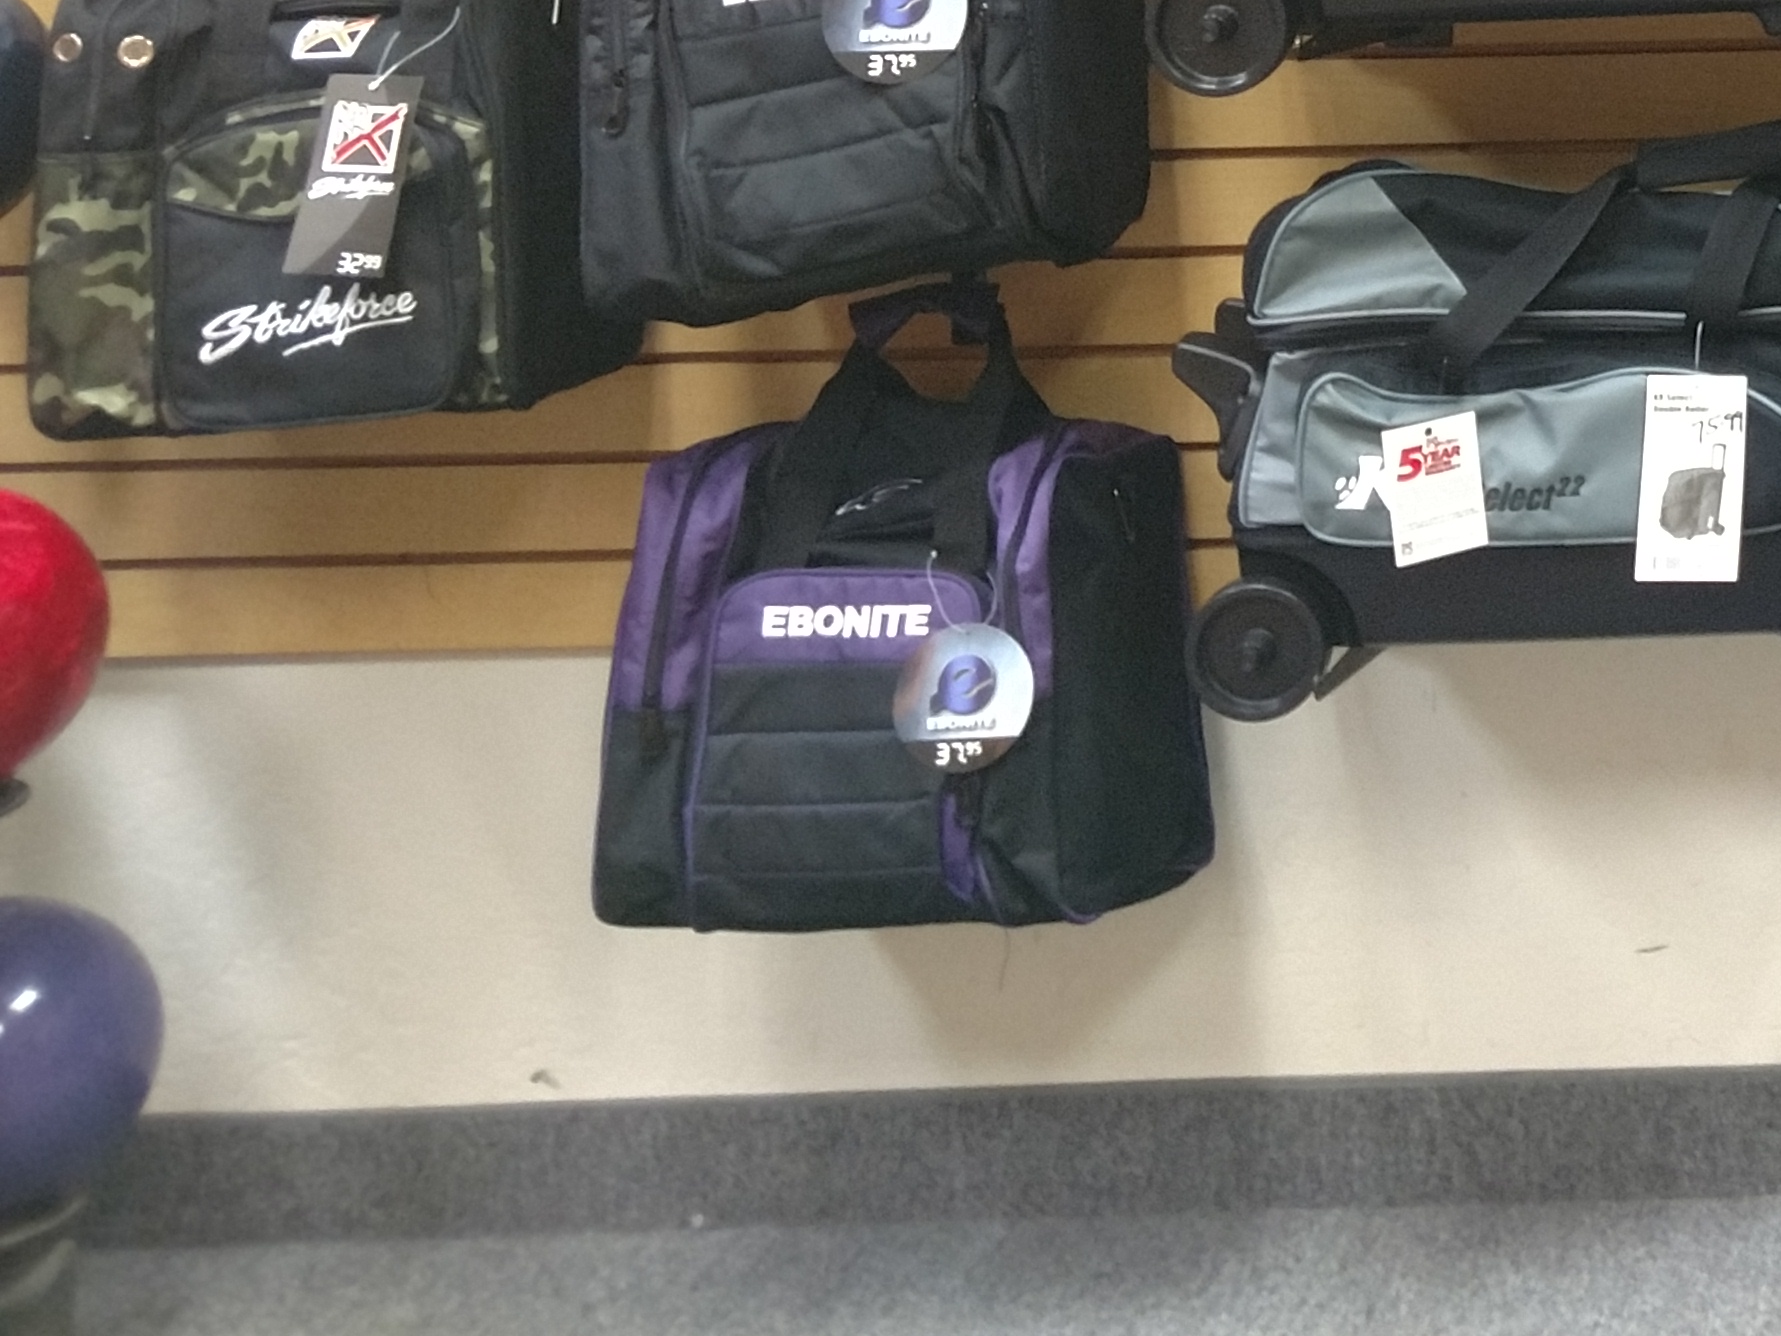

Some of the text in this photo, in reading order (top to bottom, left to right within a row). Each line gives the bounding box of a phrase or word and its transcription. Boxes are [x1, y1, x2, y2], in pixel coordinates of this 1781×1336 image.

[199, 283, 416, 364] Strikeforce
[1397, 444, 1461, 482] 5 YEAR
[1484, 476, 1586, 512] elect22
[761, 604, 931, 638] EBONITE
